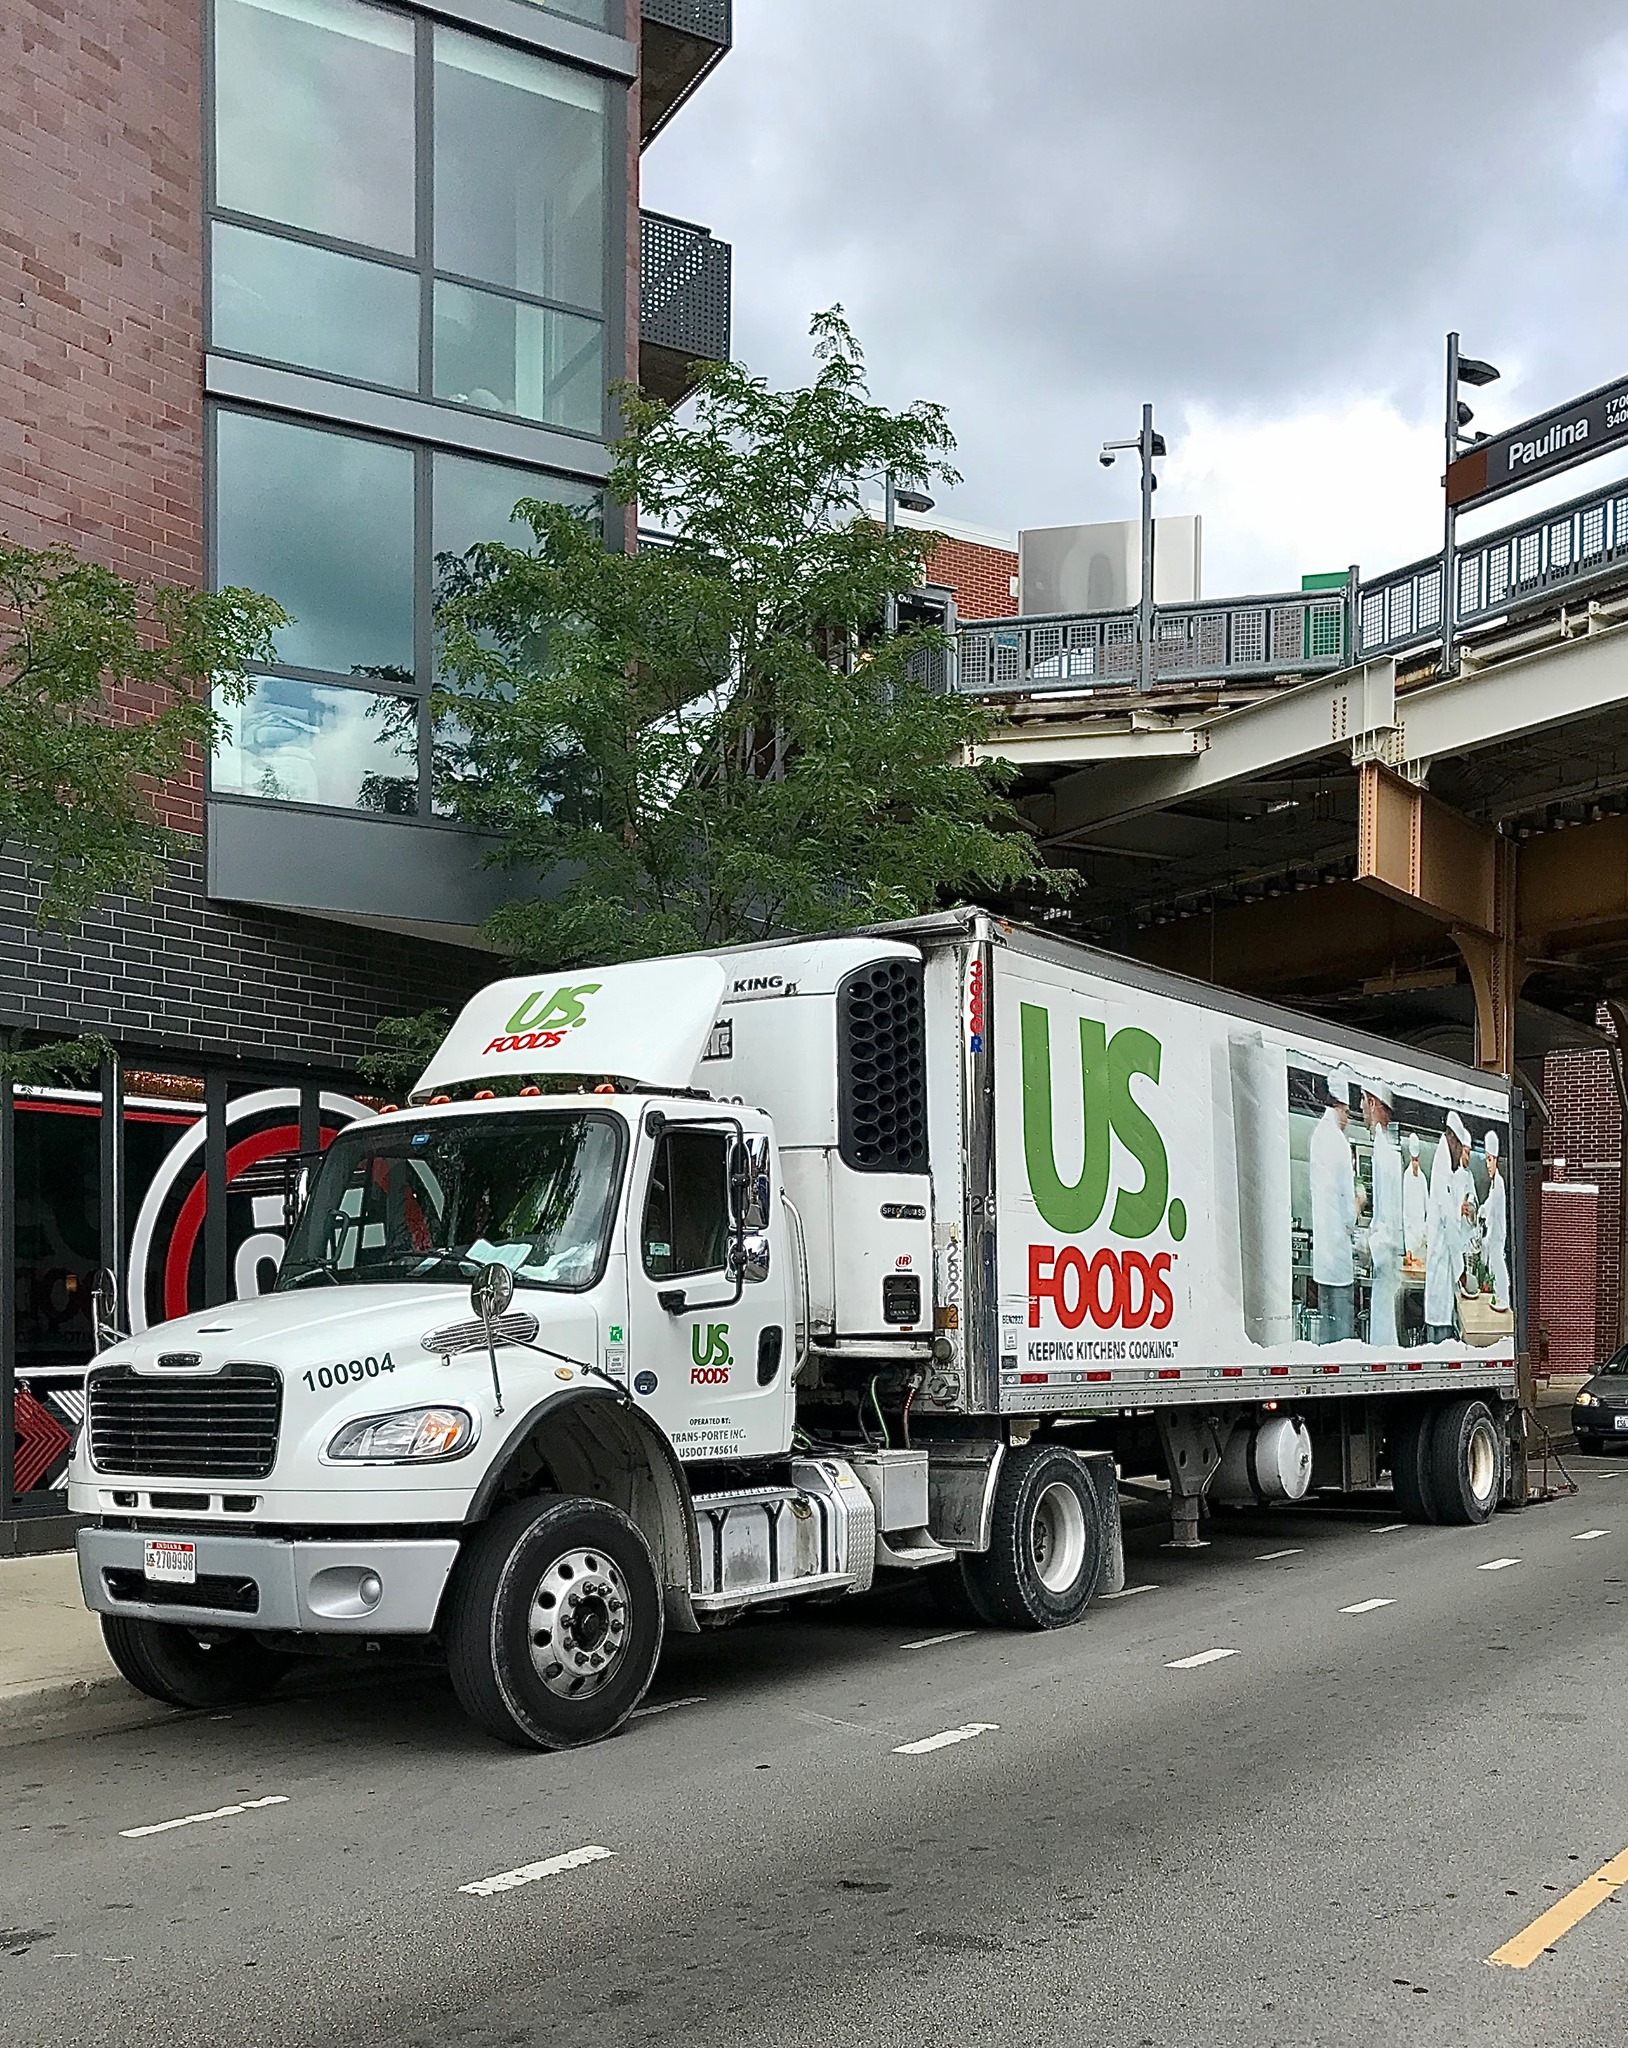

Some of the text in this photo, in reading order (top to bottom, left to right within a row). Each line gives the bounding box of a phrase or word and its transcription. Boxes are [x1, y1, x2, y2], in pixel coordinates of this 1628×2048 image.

[1508, 418, 1589, 470] Paulina
[733, 975, 783, 993] KING
[482, 1030, 568, 1055] FOODS
[1028, 1342, 1074, 1361] KEEPING
[1076, 1341, 1126, 1360] KITCHENS
[302, 1352, 396, 1392] 100904
[689, 1417, 721, 1426] OPERATED
[671, 1428, 747, 1443] TRANS-PORTE INC.
[679, 1444, 738, 1458] USDOT 745614
[156, 1543, 182, 1551] INDIANA
